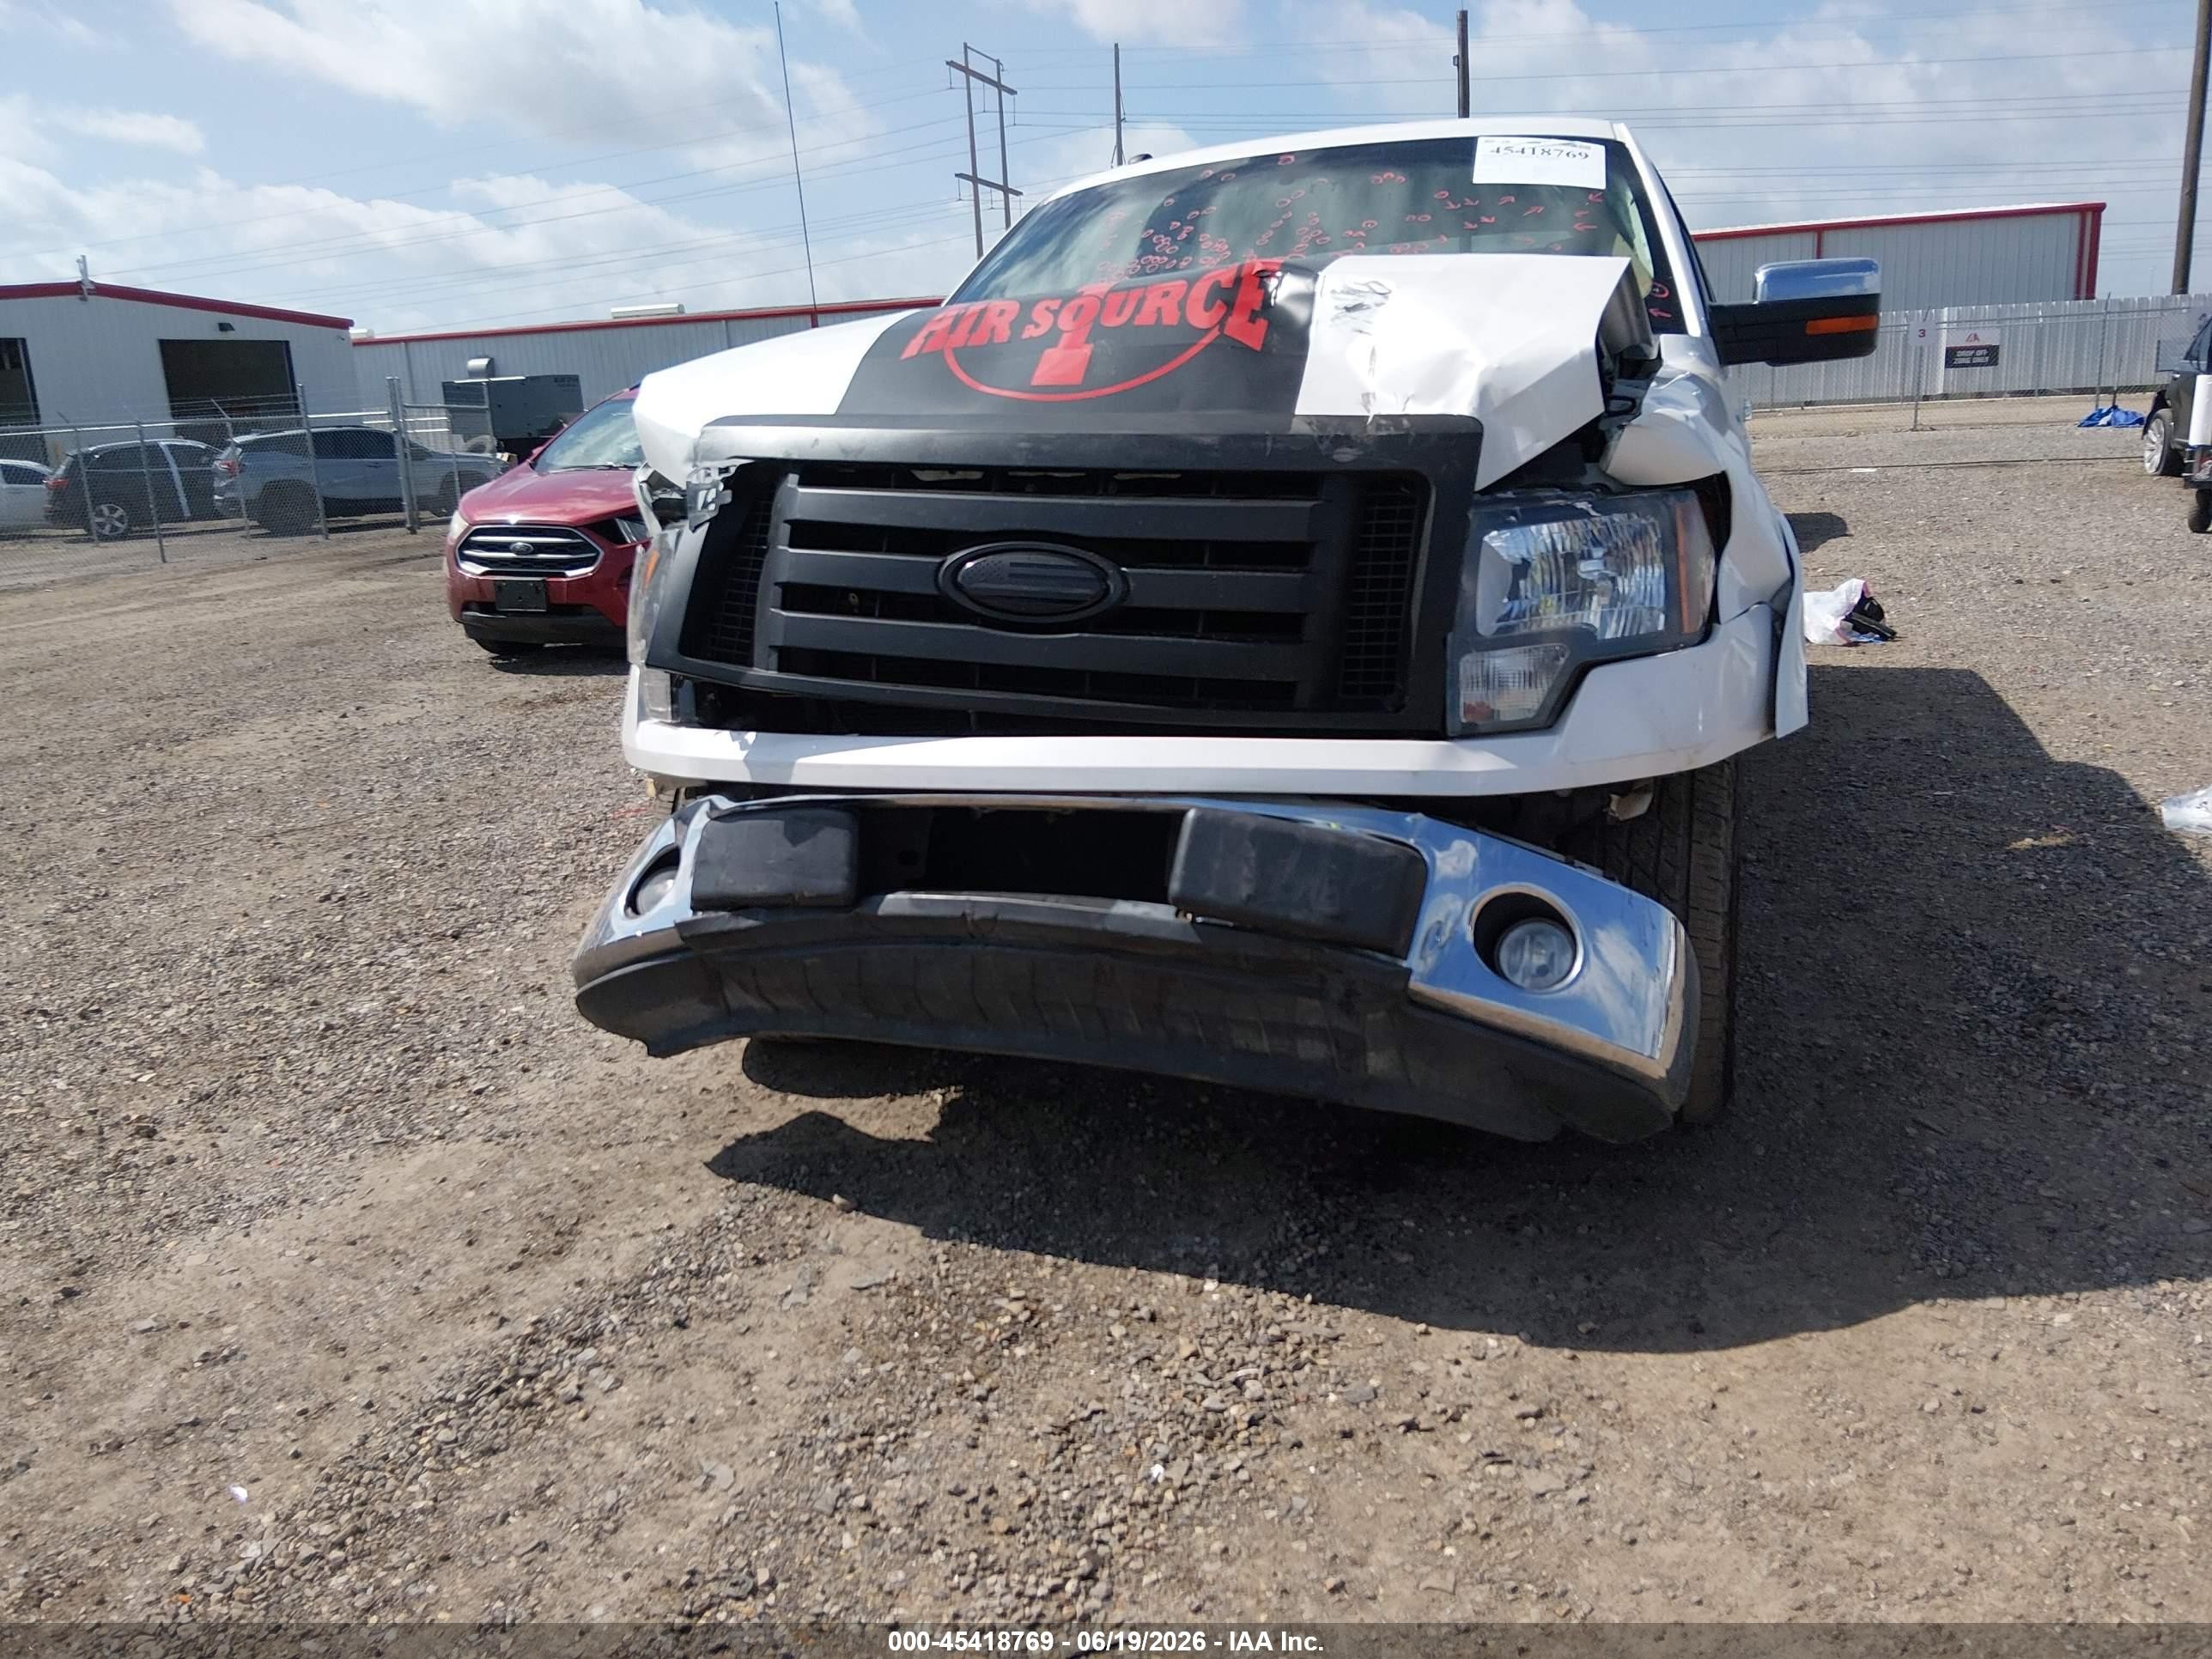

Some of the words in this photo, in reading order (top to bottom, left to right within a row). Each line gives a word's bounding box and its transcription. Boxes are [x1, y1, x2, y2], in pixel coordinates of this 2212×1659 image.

[1490, 145, 1589, 160] 45418769
[900, 299, 1022, 361] AIR
[1021, 258, 1285, 352] SOURCE
[1917, 329, 1926, 338] 3
